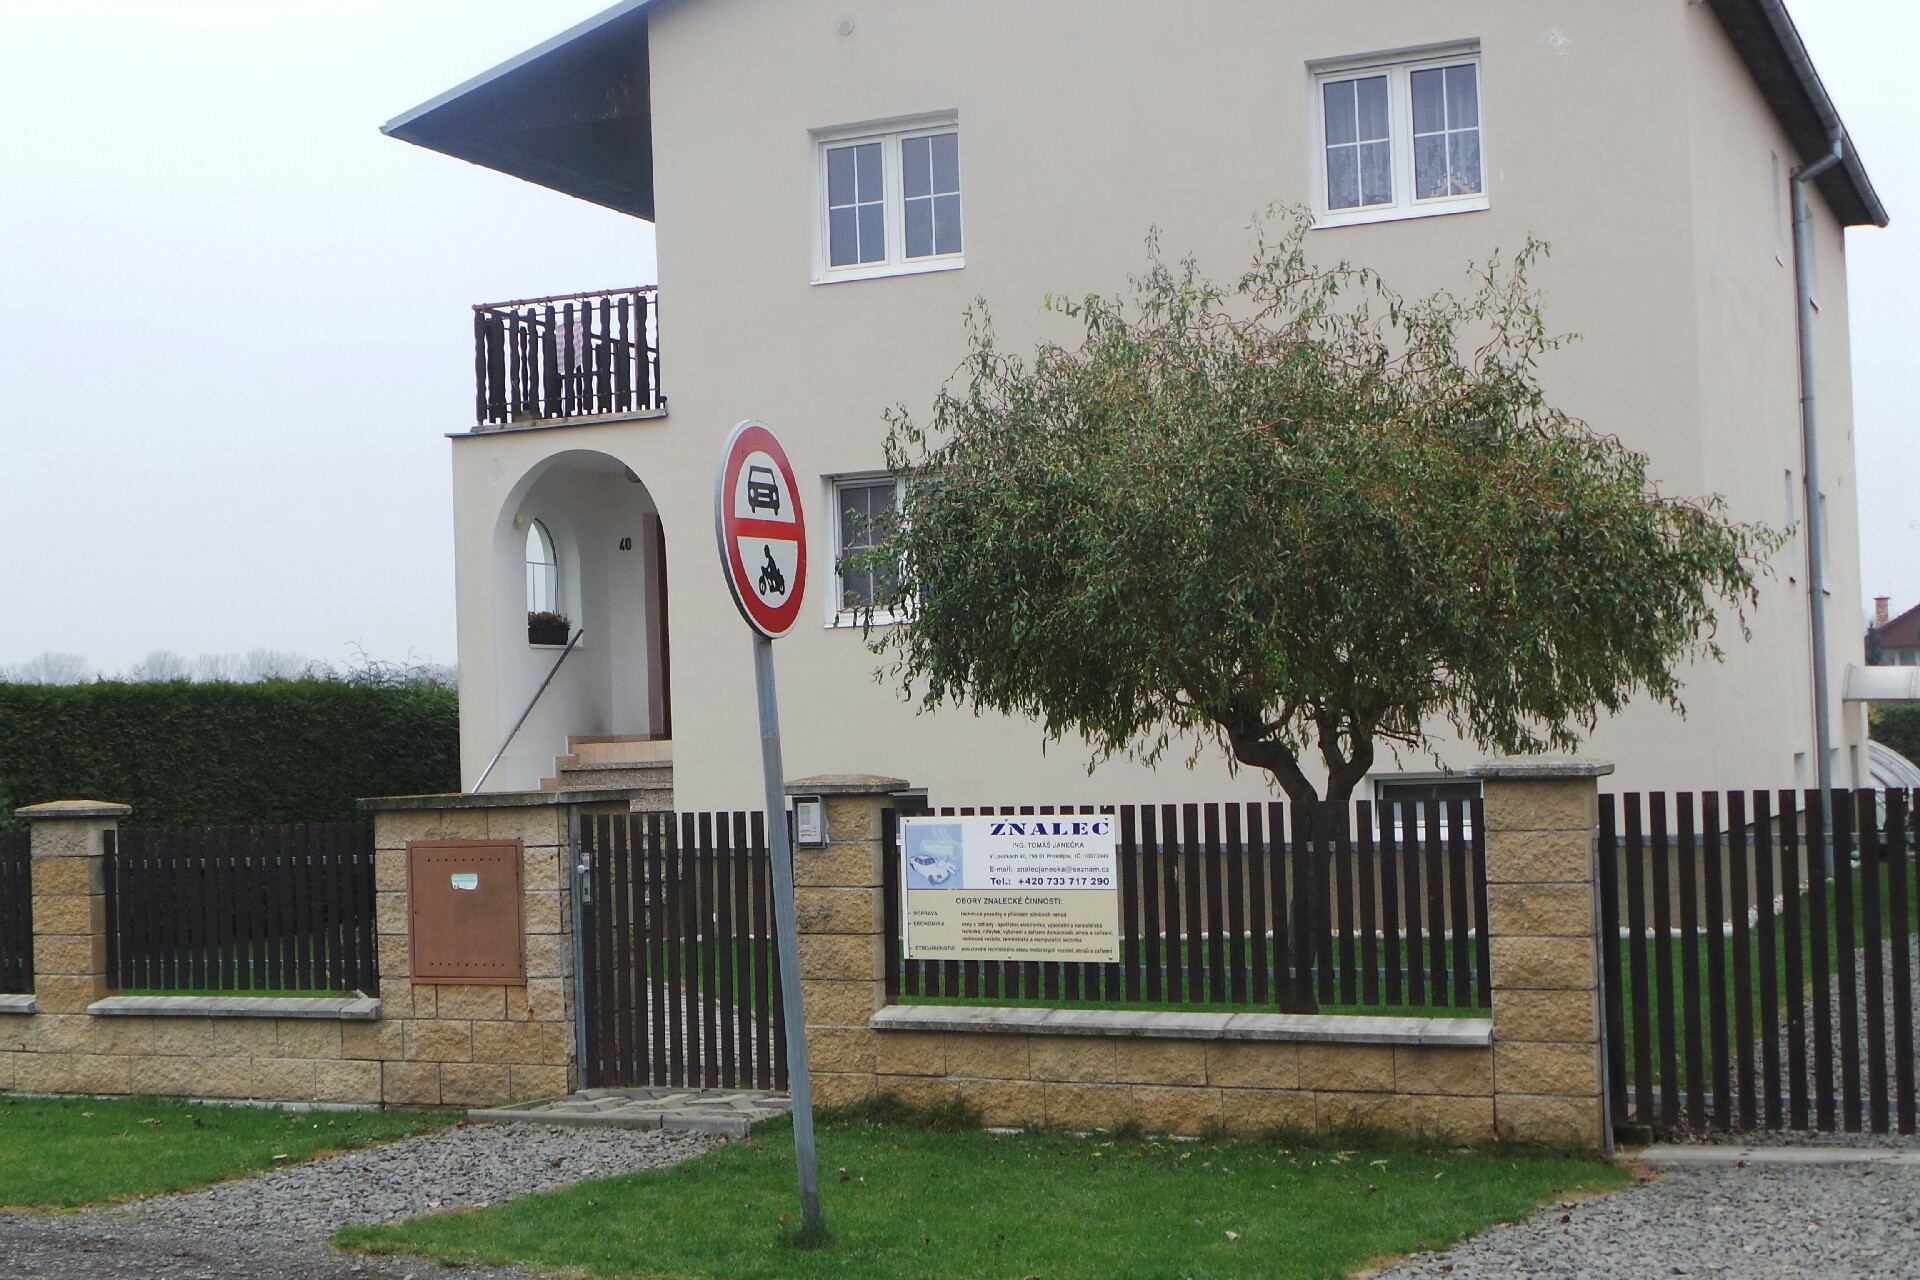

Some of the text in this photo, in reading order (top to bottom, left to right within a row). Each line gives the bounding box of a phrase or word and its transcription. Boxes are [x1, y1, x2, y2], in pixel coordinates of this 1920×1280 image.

[619, 538, 631, 550] 40
[990, 822, 1108, 835] ZNALEC
[984, 896, 1022, 904] ZNALECKÉ
[1024, 896, 1062, 904] ČINNOSTI:
